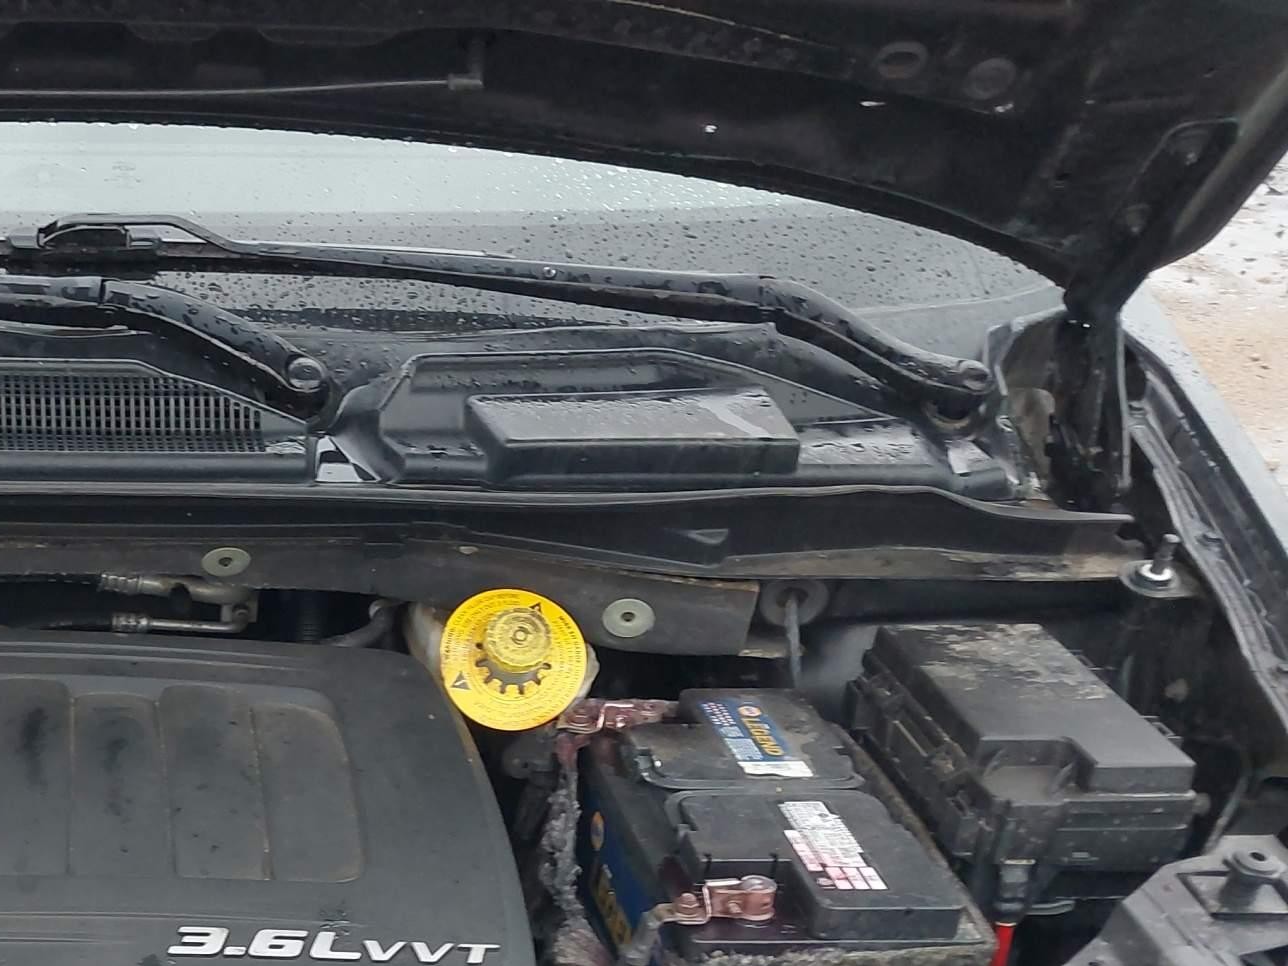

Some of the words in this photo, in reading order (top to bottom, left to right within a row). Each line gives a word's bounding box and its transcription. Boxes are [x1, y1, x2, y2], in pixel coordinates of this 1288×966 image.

[741, 717, 786, 756] LEGEND
[168, 926, 362, 961] 3.6L
[363, 940, 501, 965] VVT
